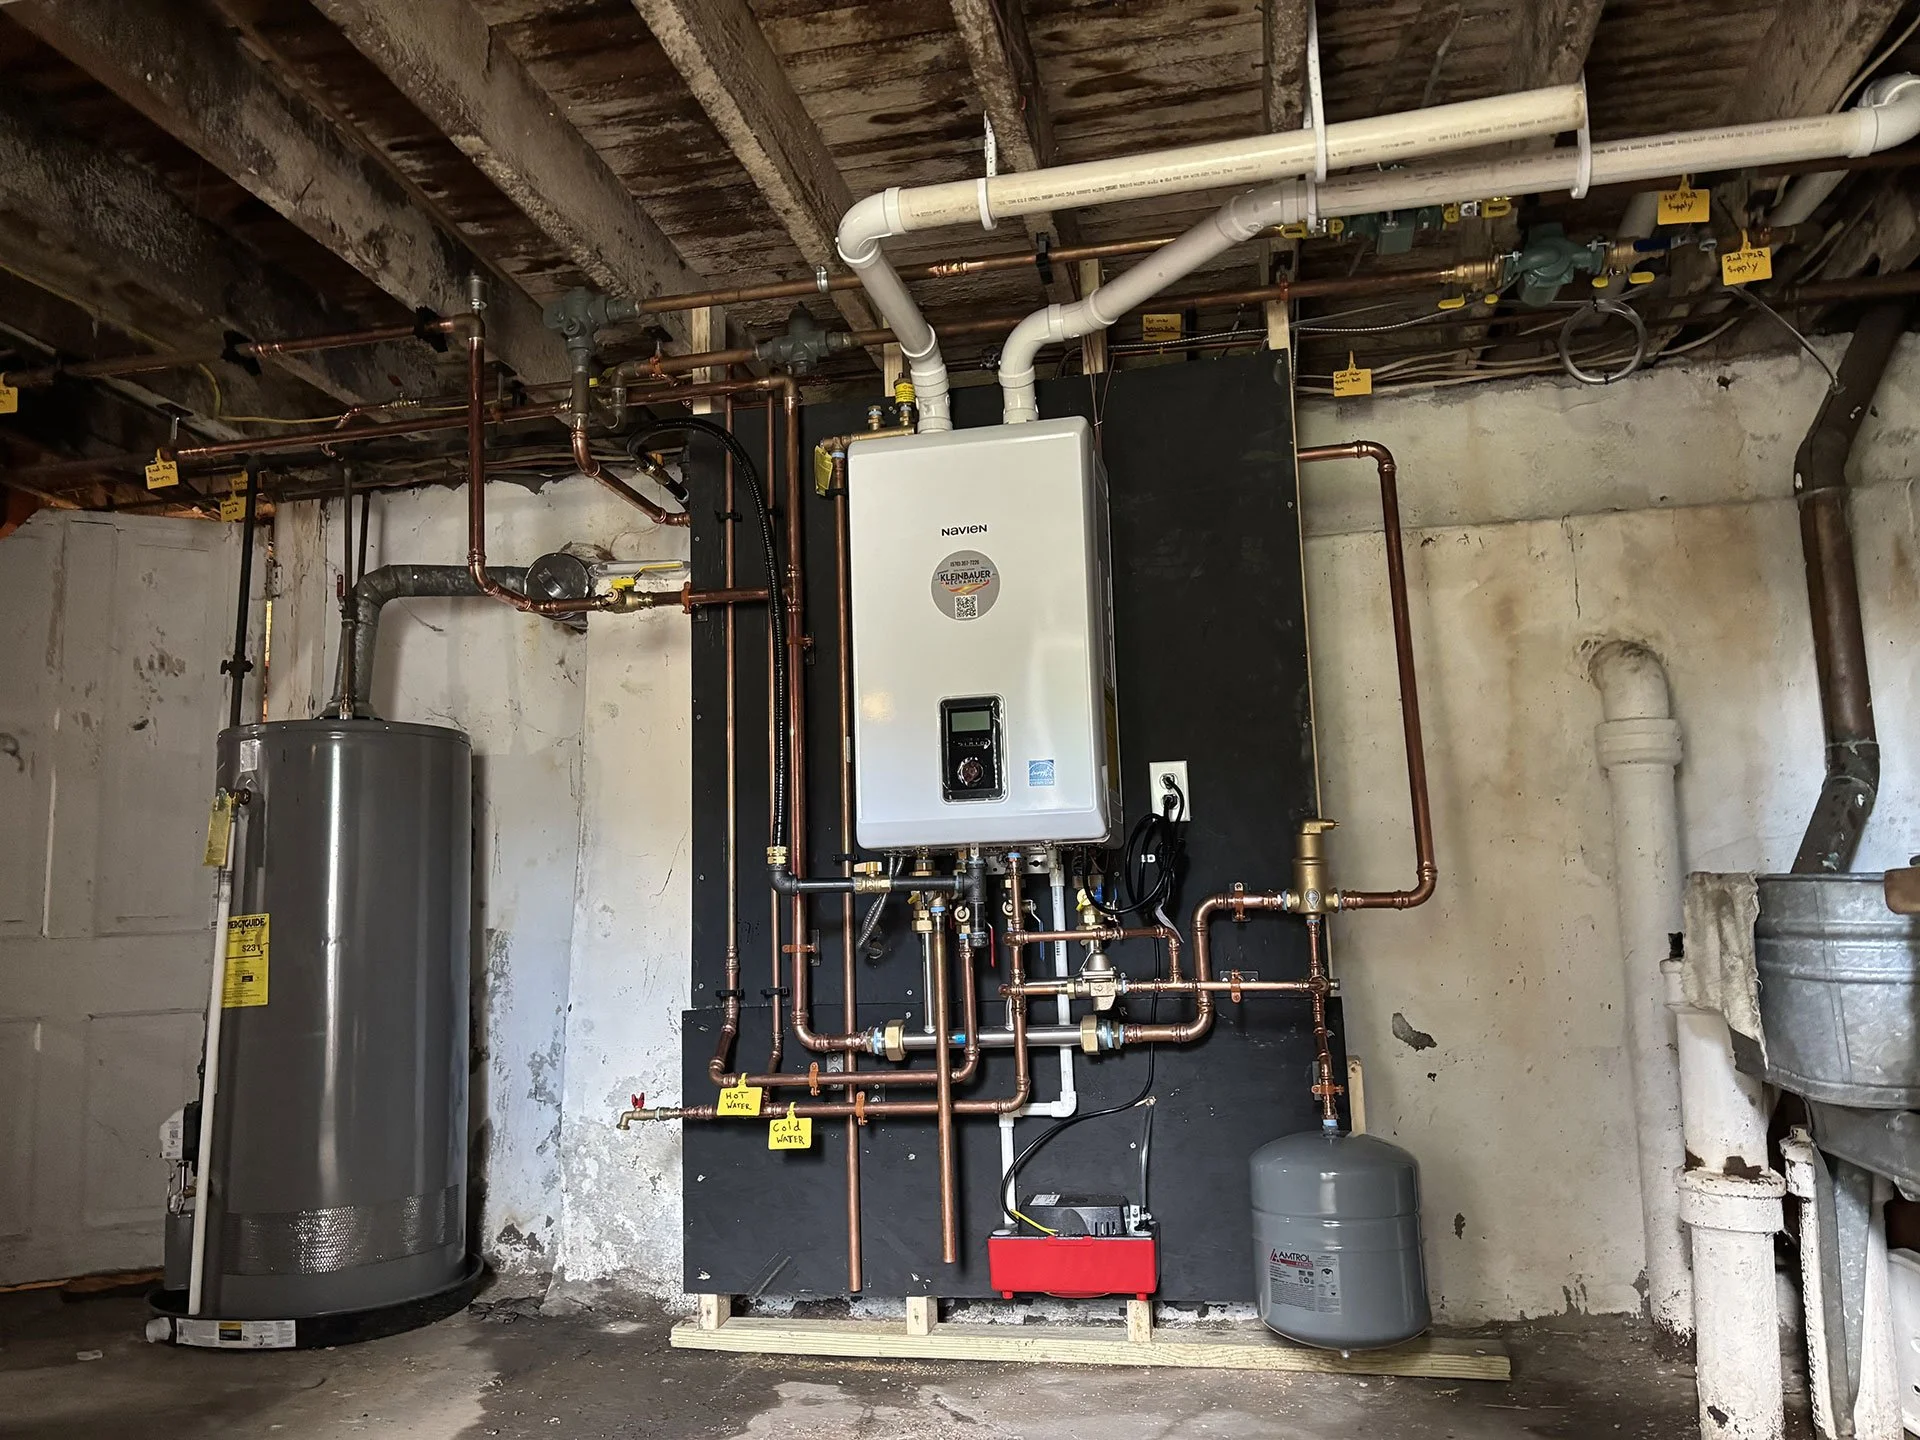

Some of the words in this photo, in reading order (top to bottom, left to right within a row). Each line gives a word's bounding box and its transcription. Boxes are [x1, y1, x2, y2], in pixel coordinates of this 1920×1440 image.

[1727, 262, 1759, 273] Supply
[940, 570, 991, 582] KLEINBAUER
[242, 944, 261, 952] $231
[726, 1100, 752, 1111] WATER
[773, 1121, 801, 1133] Cold
[776, 1134, 805, 1145] WATER
[1278, 1251, 1312, 1263] AMTROL
